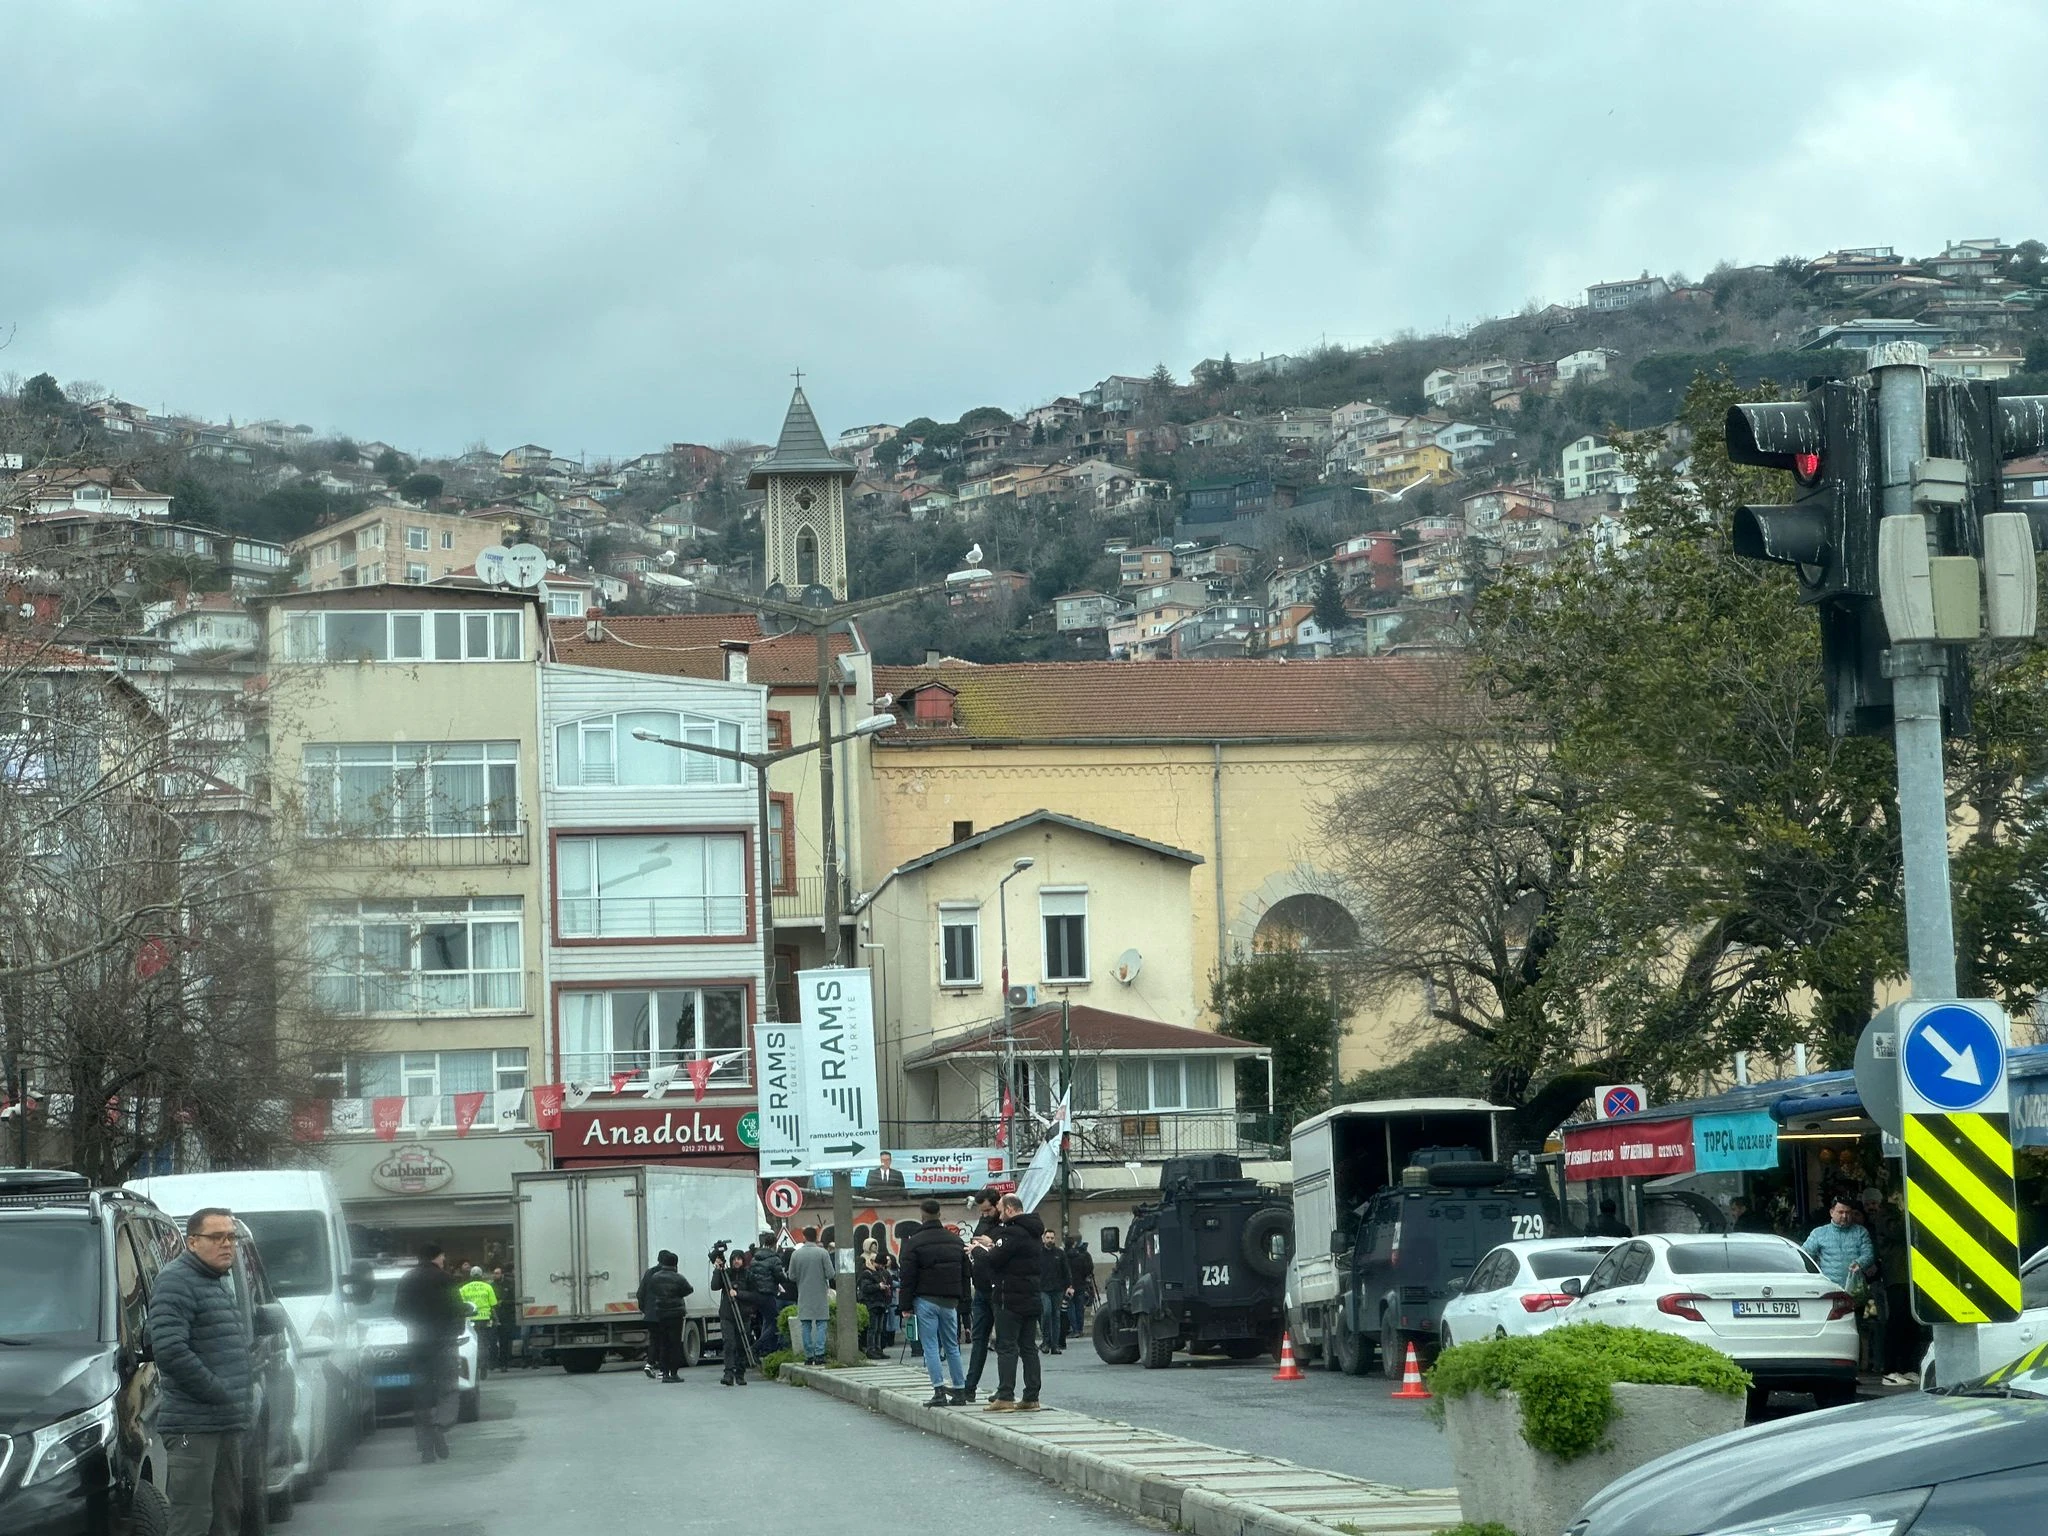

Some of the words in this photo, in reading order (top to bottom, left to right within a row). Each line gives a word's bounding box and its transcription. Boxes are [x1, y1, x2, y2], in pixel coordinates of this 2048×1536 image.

[816, 980, 846, 1080] RAMS
[767, 1032, 788, 1109] RAMS
[542, 1108, 559, 1117] CHP
[380, 1120, 398, 1128] CHP
[583, 1112, 724, 1145] Anadolu
[809, 1130, 878, 1139] ramsturkiye.com.tr
[912, 1155, 950, 1164] Sarıyer
[953, 1153, 972, 1164] için
[380, 1162, 446, 1177] Cabbarlar
[922, 1165, 945, 1173] yeni
[915, 1174, 970, 1184] başlangıç!
[1511, 1215, 1544, 1240] Z29
[1202, 1265, 1229, 1286] Z34
[1740, 1303, 1751, 1313] 34
[1755, 1303, 1767, 1313] YL
[1772, 1303, 1797, 1313] 6782
